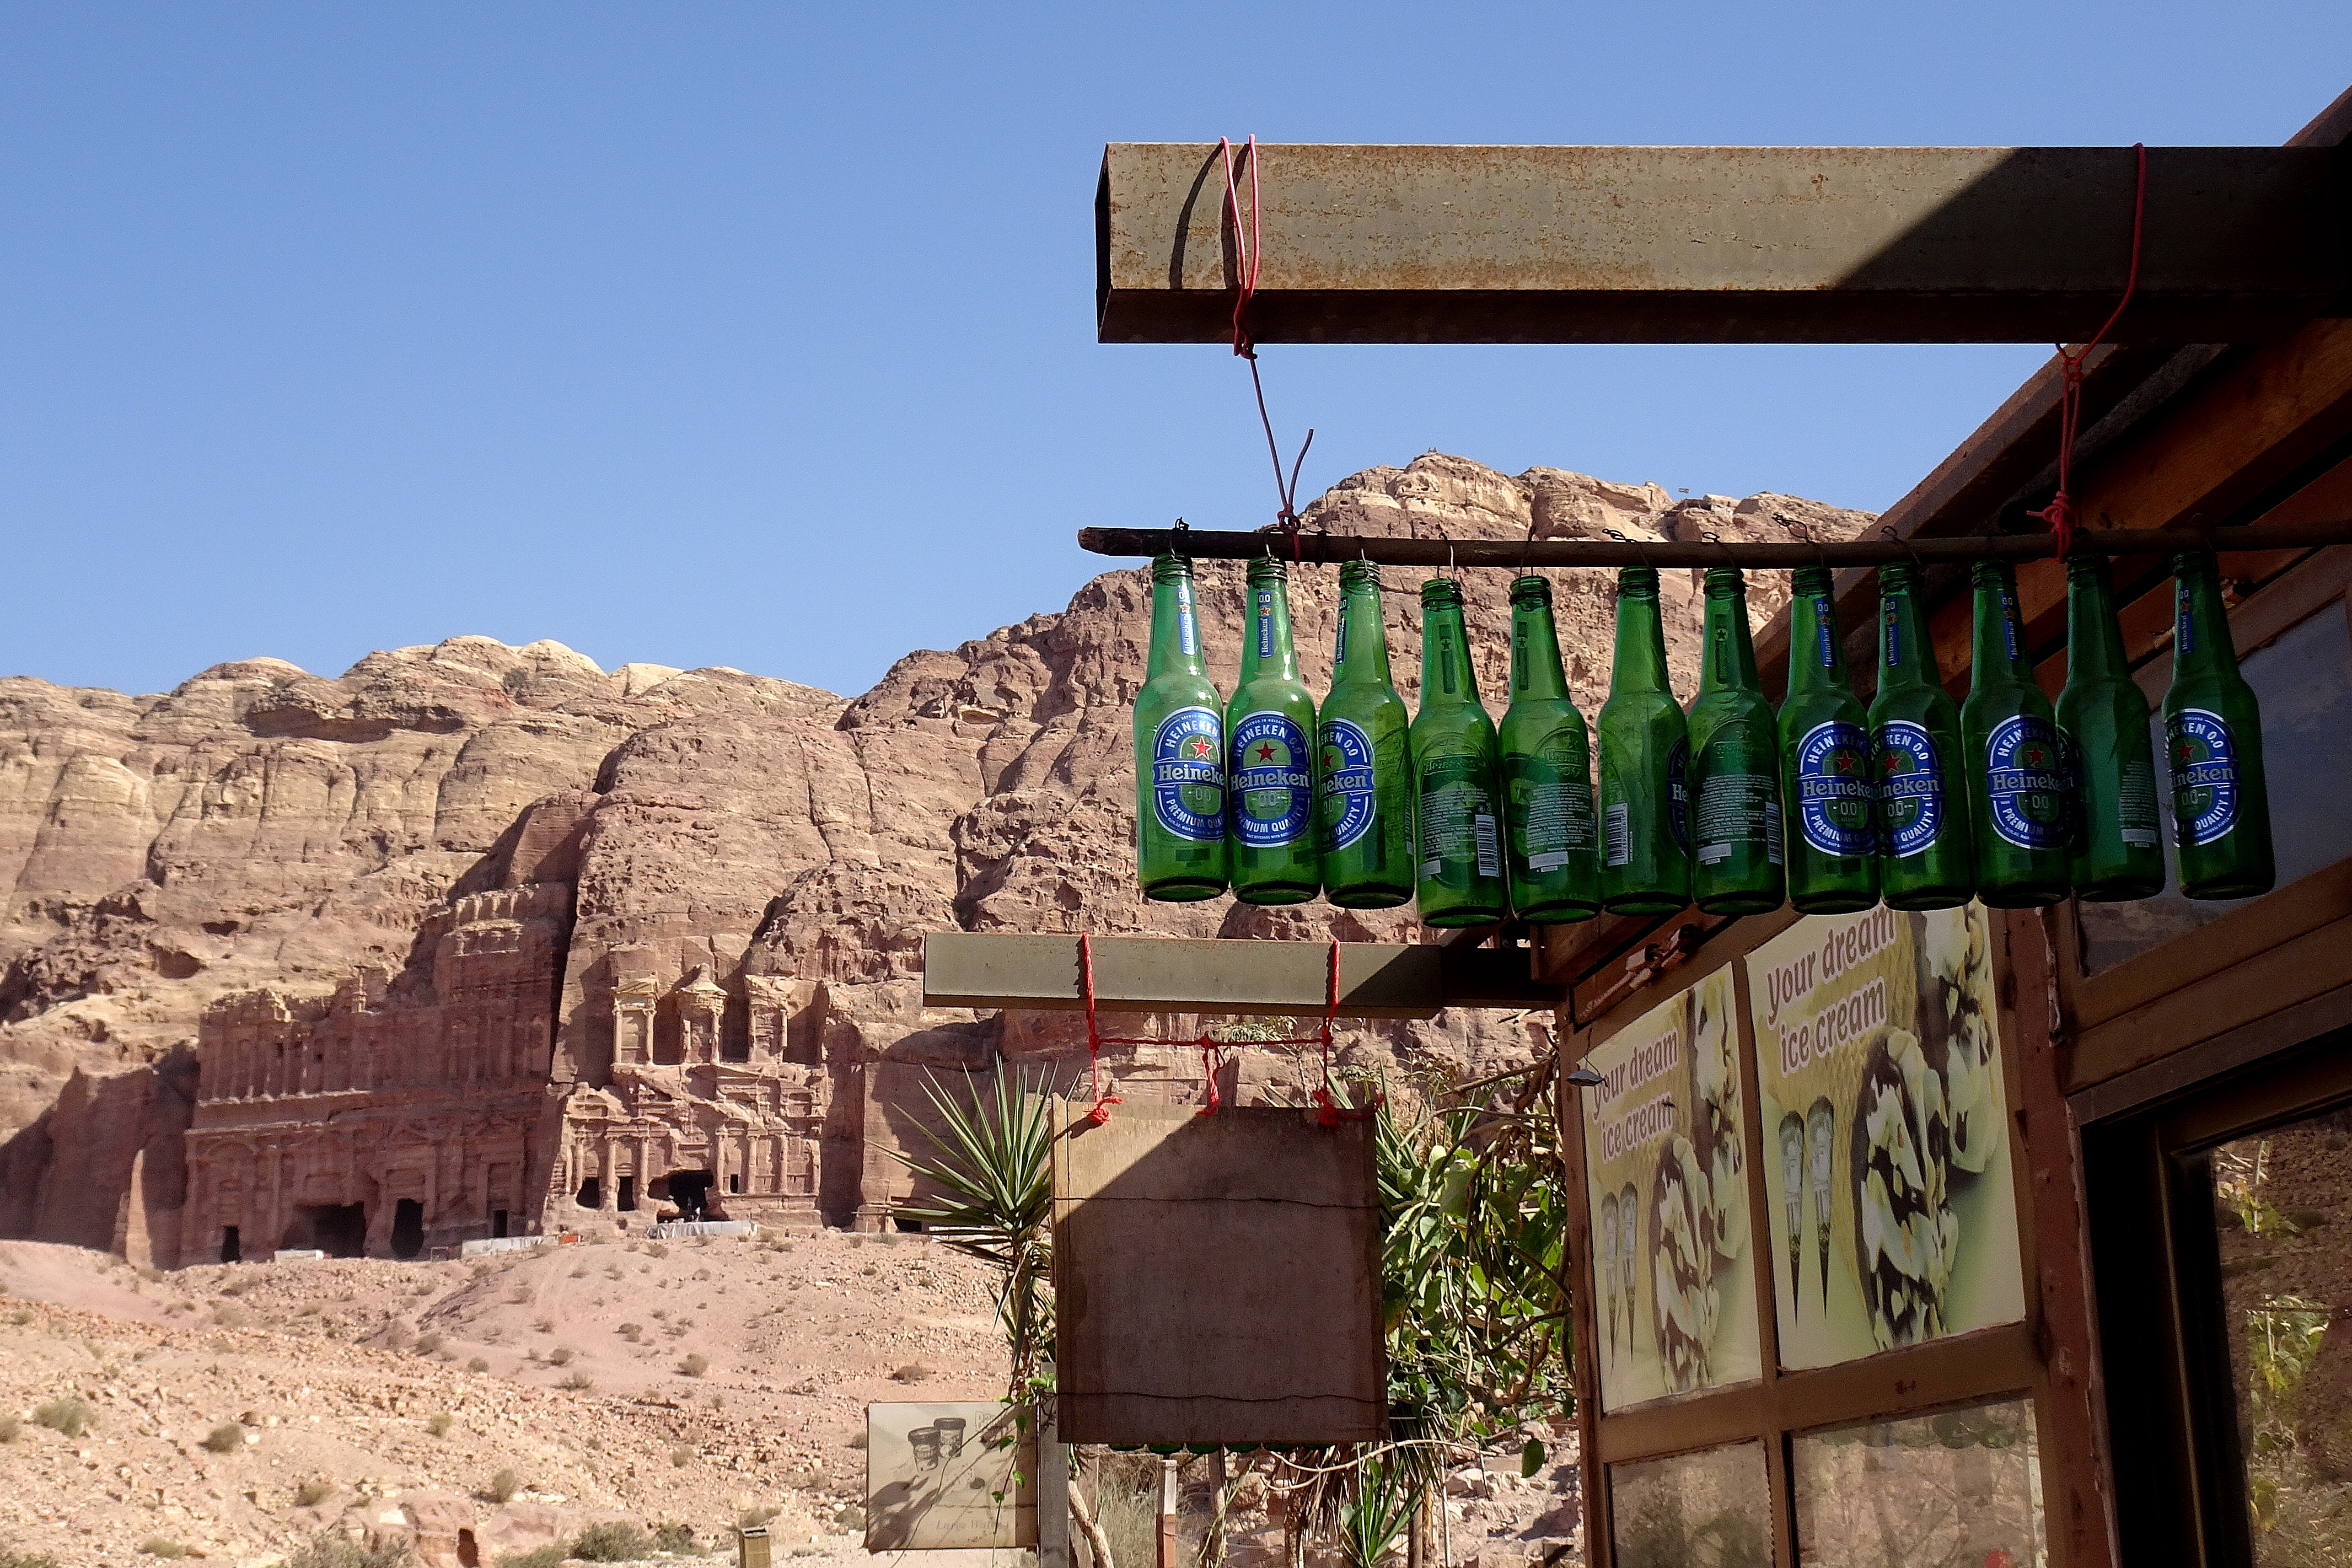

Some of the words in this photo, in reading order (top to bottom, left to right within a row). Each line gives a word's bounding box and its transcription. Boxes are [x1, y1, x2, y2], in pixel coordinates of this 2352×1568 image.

[1261, 618, 1269, 653] Heineken
[1234, 724, 1288, 756] HEINEKEN
[1344, 739, 1358, 756] 0.0
[1913, 743, 1929, 760] 0.0
[2206, 731, 2224, 748] 0.0
[1158, 764, 1226, 786] Heineke
[1231, 769, 1310, 792] Heineken
[1320, 775, 1367, 796] neken
[1166, 798, 1205, 828] PREMIUM
[1271, 804, 1304, 832] QUALITY
[1900, 810, 1934, 842] QUALITY
[2194, 799, 2229, 831] QUALITY
[1766, 950, 1817, 1026] your
[1822, 906, 1895, 980] dream
[1780, 1023, 1810, 1073] ice
[1815, 981, 1886, 1053] cream
[1593, 1061, 1626, 1121] your
[1629, 1030, 1678, 1087] dream
[1602, 1119, 1621, 1161] ice
[1625, 1094, 1672, 1147] cream
